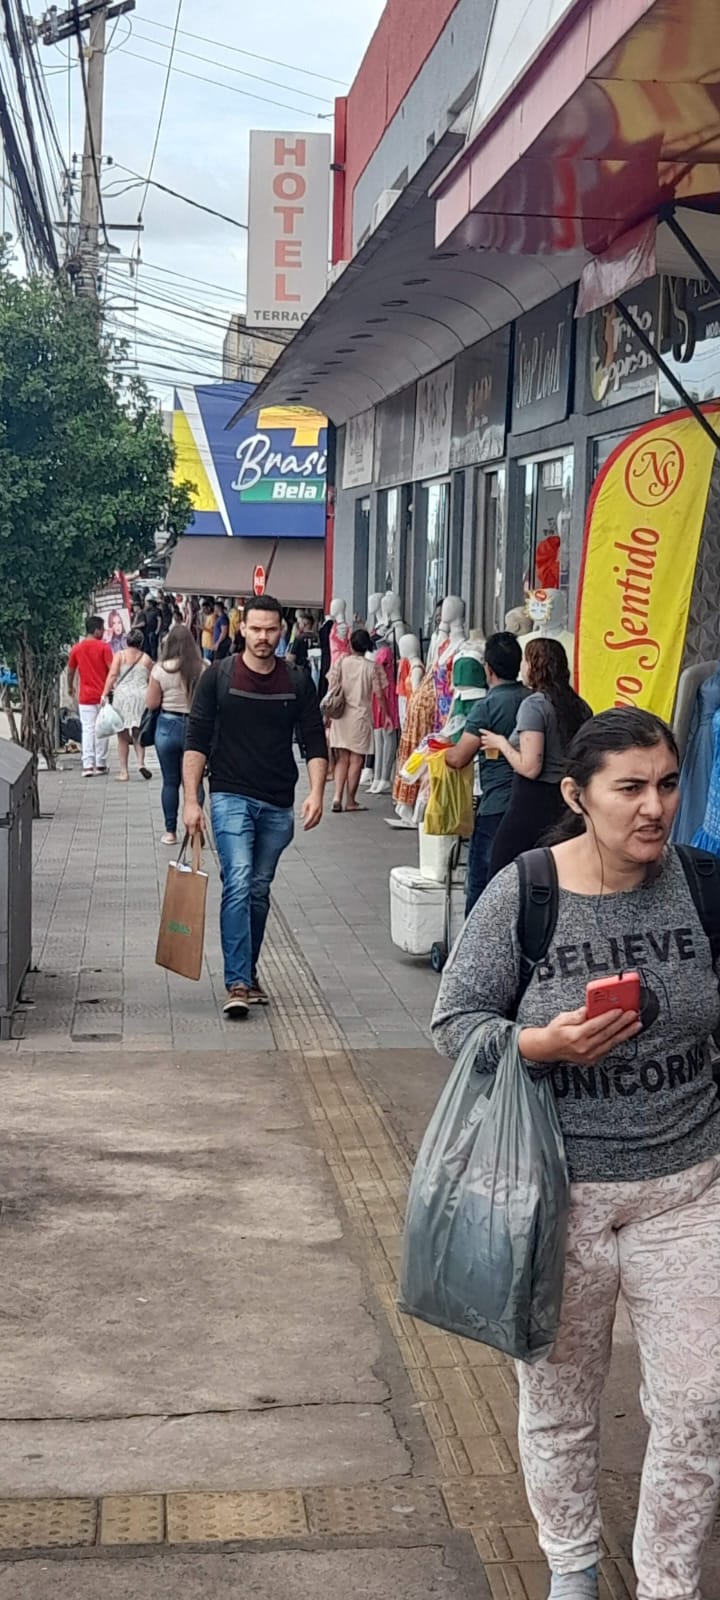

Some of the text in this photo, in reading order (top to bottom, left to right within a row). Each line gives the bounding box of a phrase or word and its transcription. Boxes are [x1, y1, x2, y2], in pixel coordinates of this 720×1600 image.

[272, 137, 306, 302] HOTEL
[253, 310, 309, 322] TERRAC
[231, 433, 328, 491] Brasi
[272, 482, 317, 499] Bela
[603, 527, 661, 671] Sentido
[535, 928, 697, 982] BELIEVE
